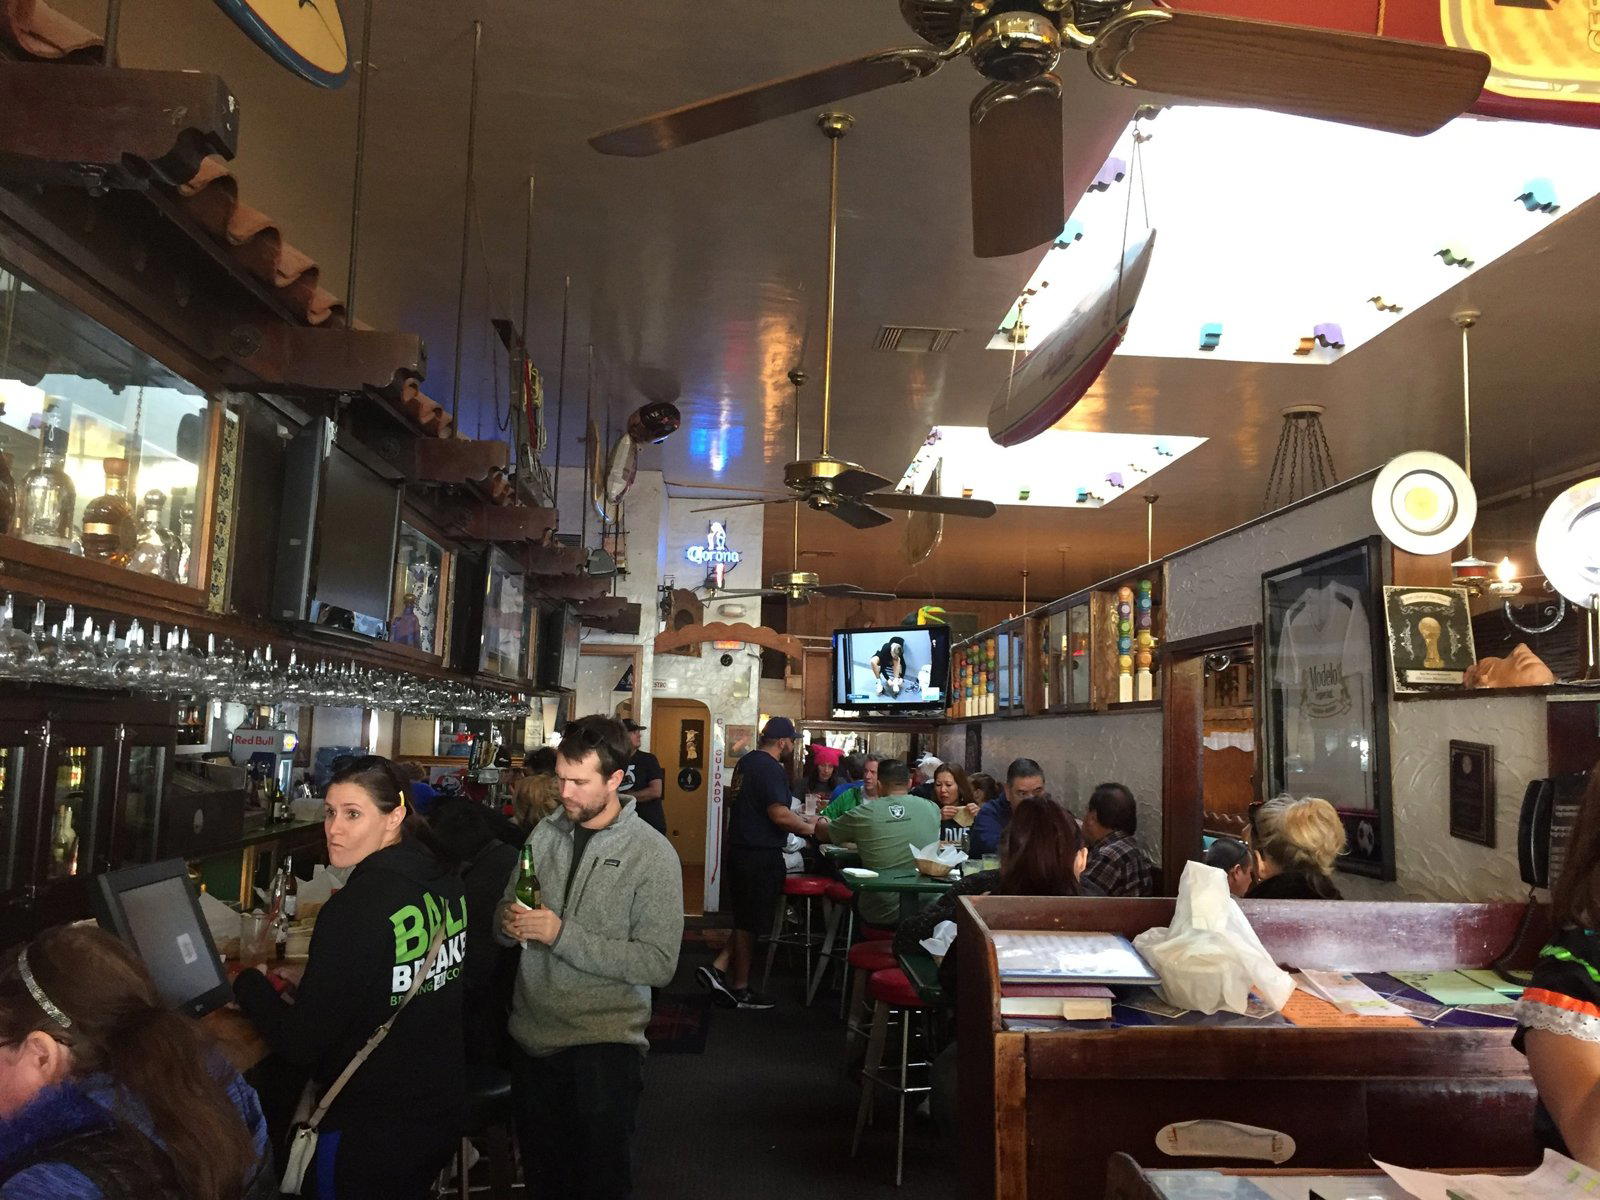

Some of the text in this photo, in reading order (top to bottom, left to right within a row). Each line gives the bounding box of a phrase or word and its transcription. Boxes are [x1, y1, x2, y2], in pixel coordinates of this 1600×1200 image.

[687, 546, 740, 564] Corona
[235, 736, 274, 745] Red Bull
[714, 750, 723, 803] CUIDADO
